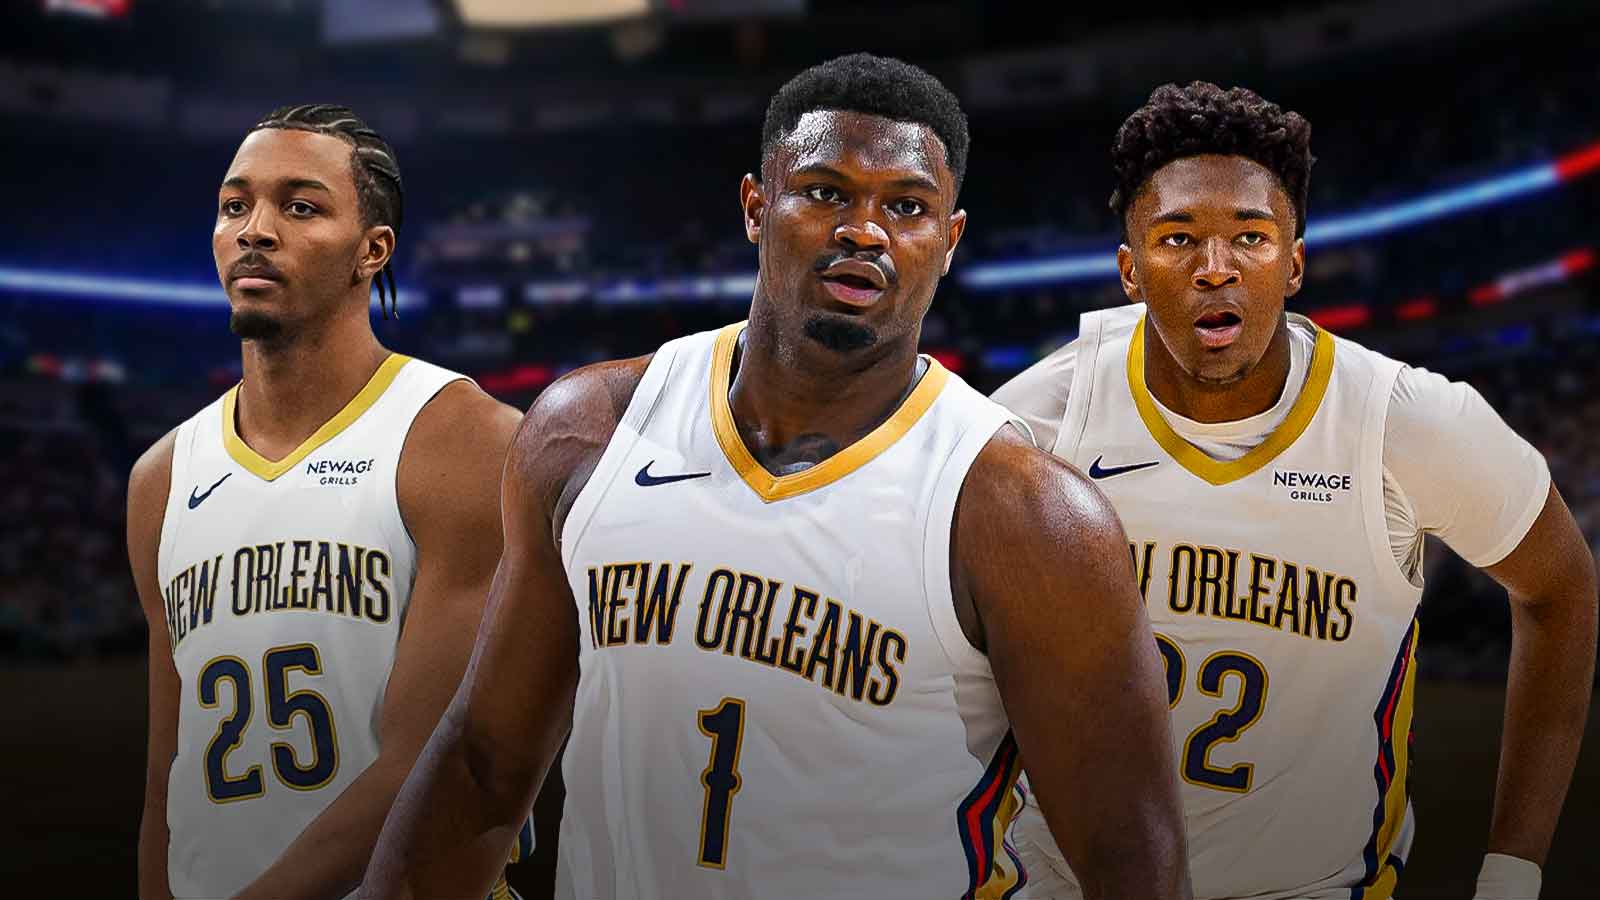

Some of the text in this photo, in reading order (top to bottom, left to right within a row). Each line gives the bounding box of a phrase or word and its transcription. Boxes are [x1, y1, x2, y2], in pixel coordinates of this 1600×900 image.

[319, 476, 358, 486] GRILLS
[1273, 471, 1351, 490] NEWAGE
[1290, 490, 1332, 502] GRILLS
[230, 539, 392, 625] ORLEANS
[1167, 541, 1357, 643] ORLEANS
[587, 561, 909, 707] NEW ORLEANS
[197, 643, 340, 805] 25
[697, 696, 747, 871] 1
